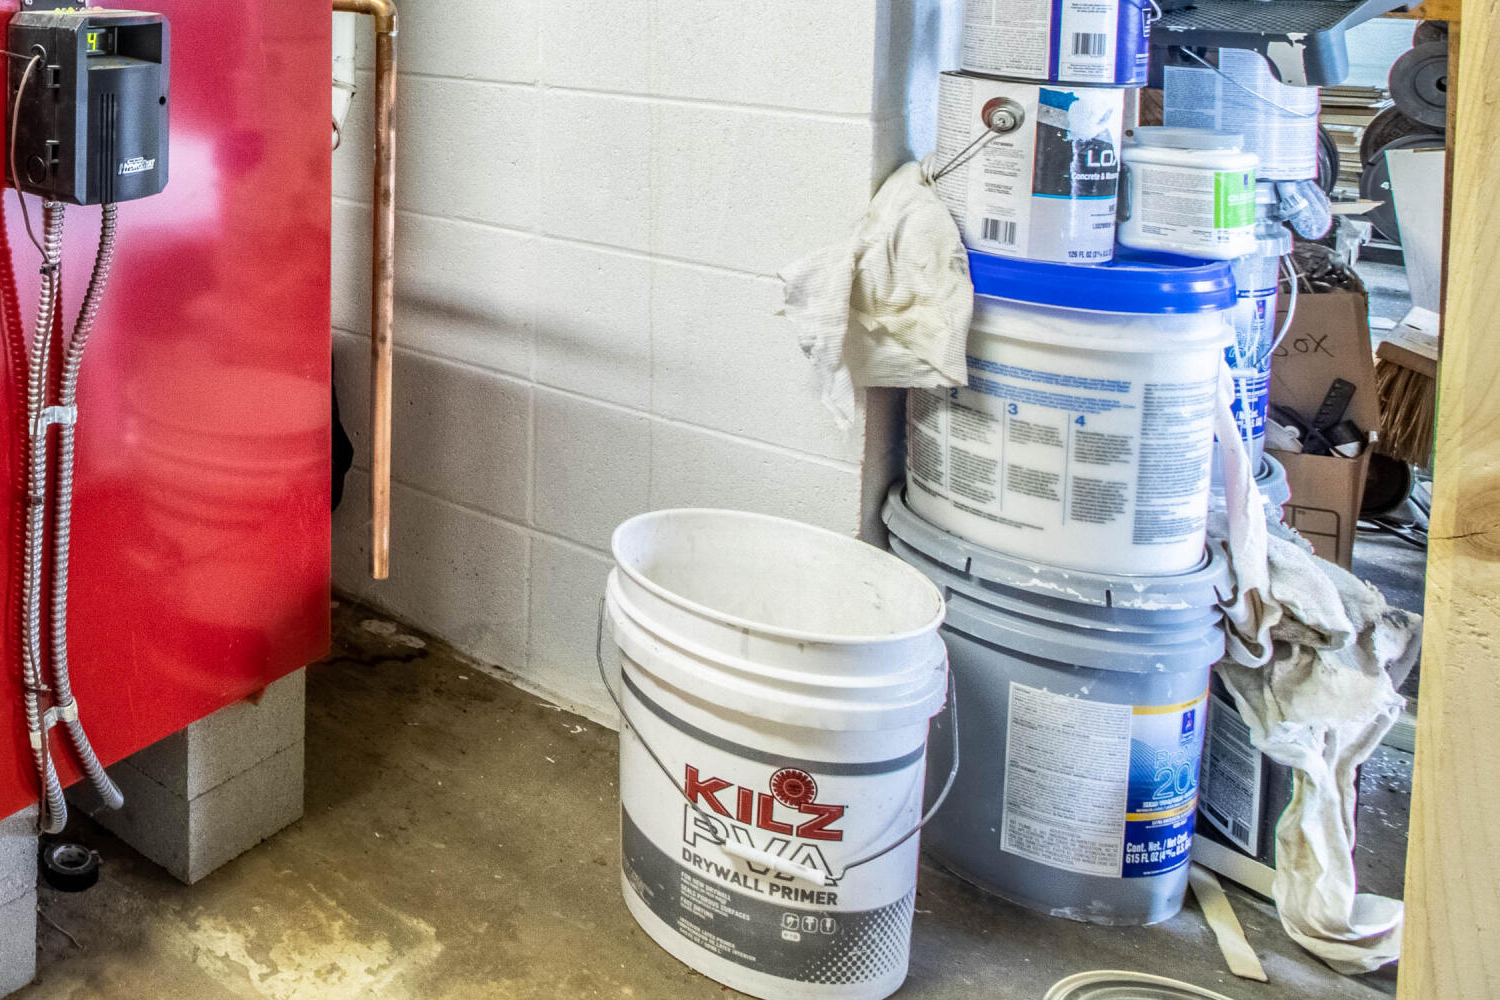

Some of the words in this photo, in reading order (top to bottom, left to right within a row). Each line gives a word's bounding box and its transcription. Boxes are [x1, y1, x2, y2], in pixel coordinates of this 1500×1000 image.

[950, 387, 959, 400] 2
[1007, 403, 1019, 416] 3
[1073, 415, 1087, 428] 4
[684, 762, 845, 842] KILZ
[683, 803, 839, 888] PVA
[1125, 841, 1147, 853] Cont.
[1125, 852, 1140, 864] 615
[1141, 852, 1150, 863] FL
[681, 847, 764, 894] DRYWALL
[769, 882, 839, 906] PRIMER
[720, 904, 751, 921] SURFACES
